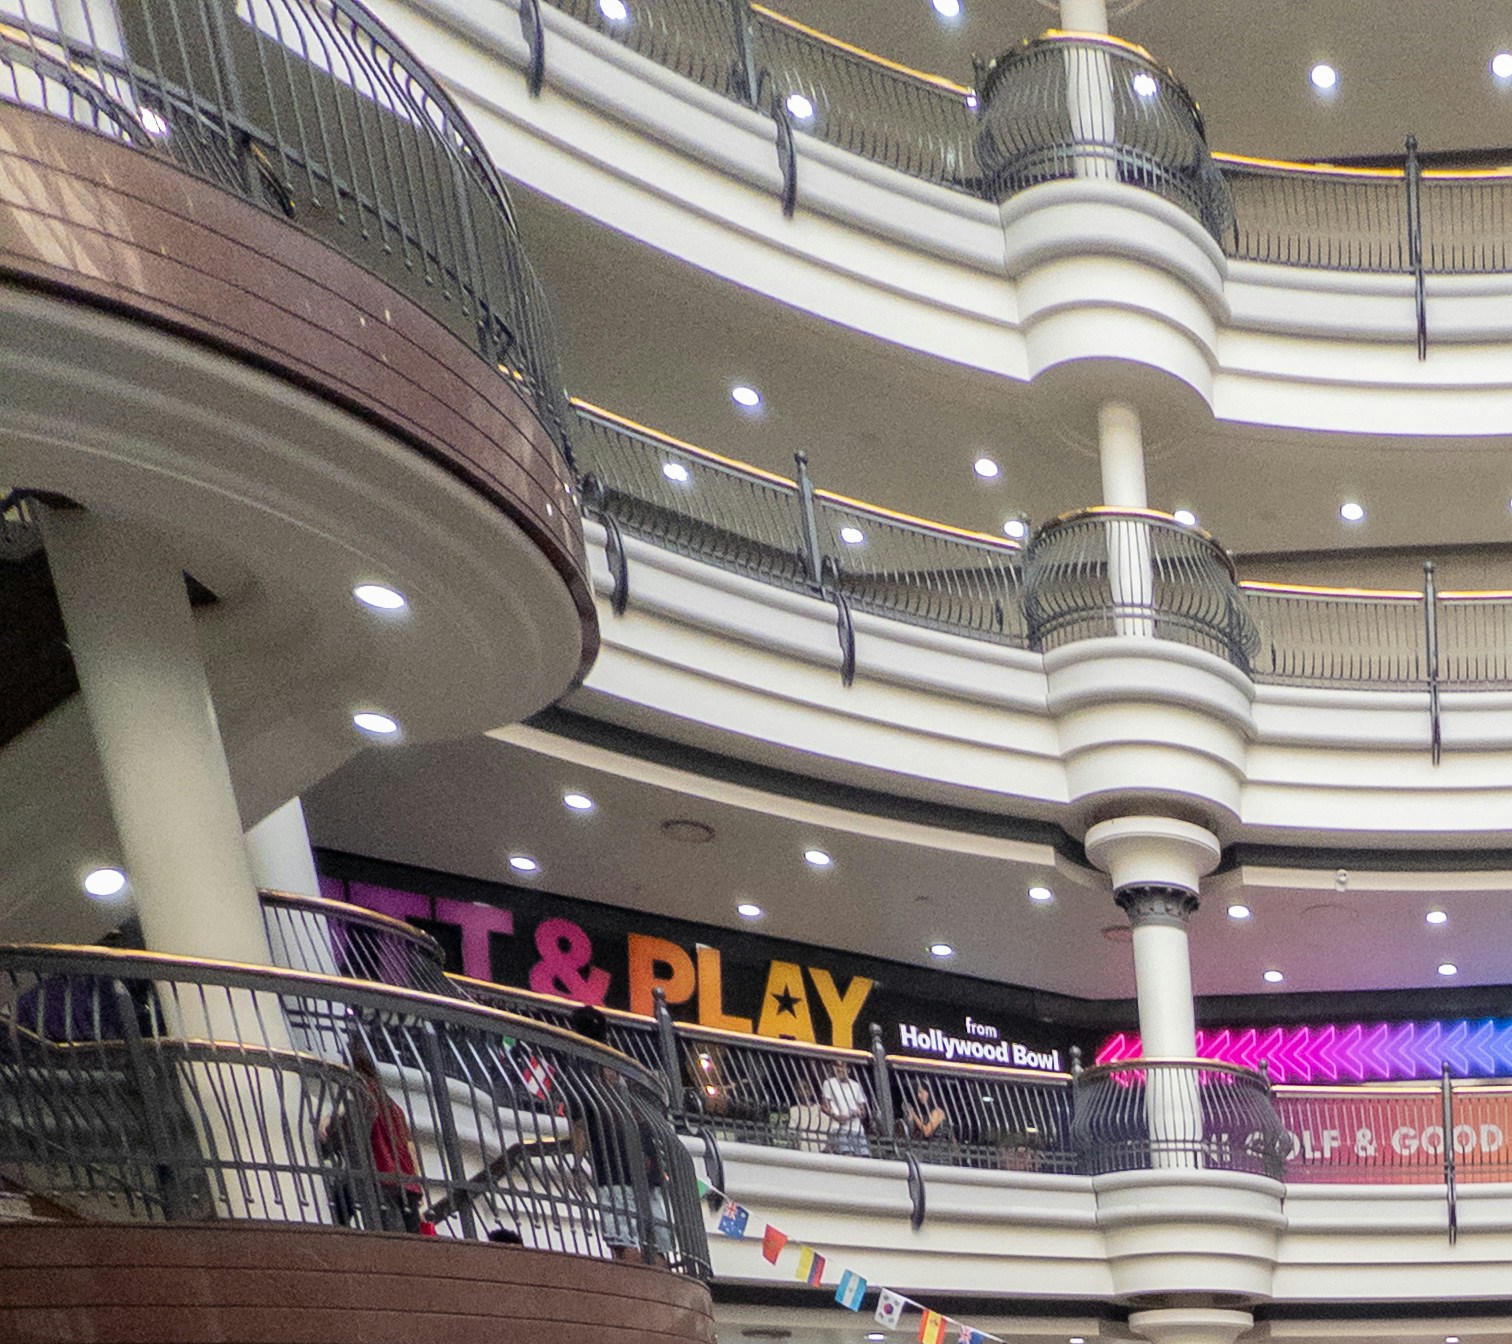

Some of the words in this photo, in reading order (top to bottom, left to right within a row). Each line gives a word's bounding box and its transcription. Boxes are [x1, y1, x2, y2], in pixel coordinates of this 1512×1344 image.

[530, 918, 611, 1008] &
[628, 933, 873, 1049] PLAY
[899, 1024, 1010, 1063] Hollywood
[1012, 1043, 1060, 1071] Bowl
[965, 1017, 998, 1039] from
[1354, 1127, 1378, 1157] &
[1391, 1123, 1503, 1156] GOOD
